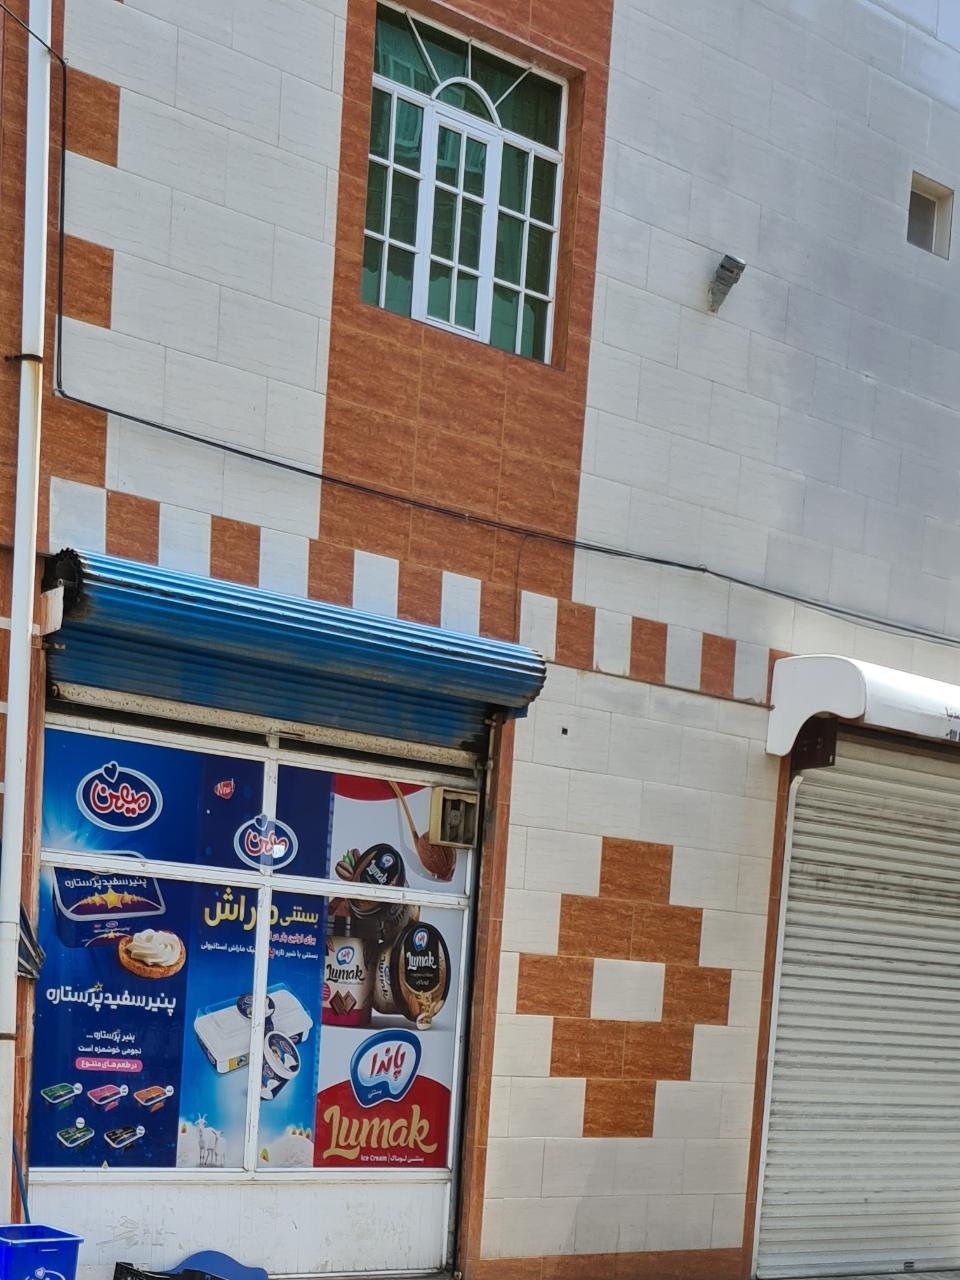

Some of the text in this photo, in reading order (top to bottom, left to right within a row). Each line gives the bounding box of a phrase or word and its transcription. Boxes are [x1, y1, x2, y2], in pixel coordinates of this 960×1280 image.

[90, 780, 151, 817] میهن
[280, 906, 319, 928] بستنی
[406, 951, 438, 971] Lumak
[326, 963, 366, 983] Lumak
[104, 990, 146, 1010] سفید
[145, 993, 177, 1016] پنیر
[370, 1043, 407, 1081] پاندا
[323, 1104, 438, 1160] Lumak
